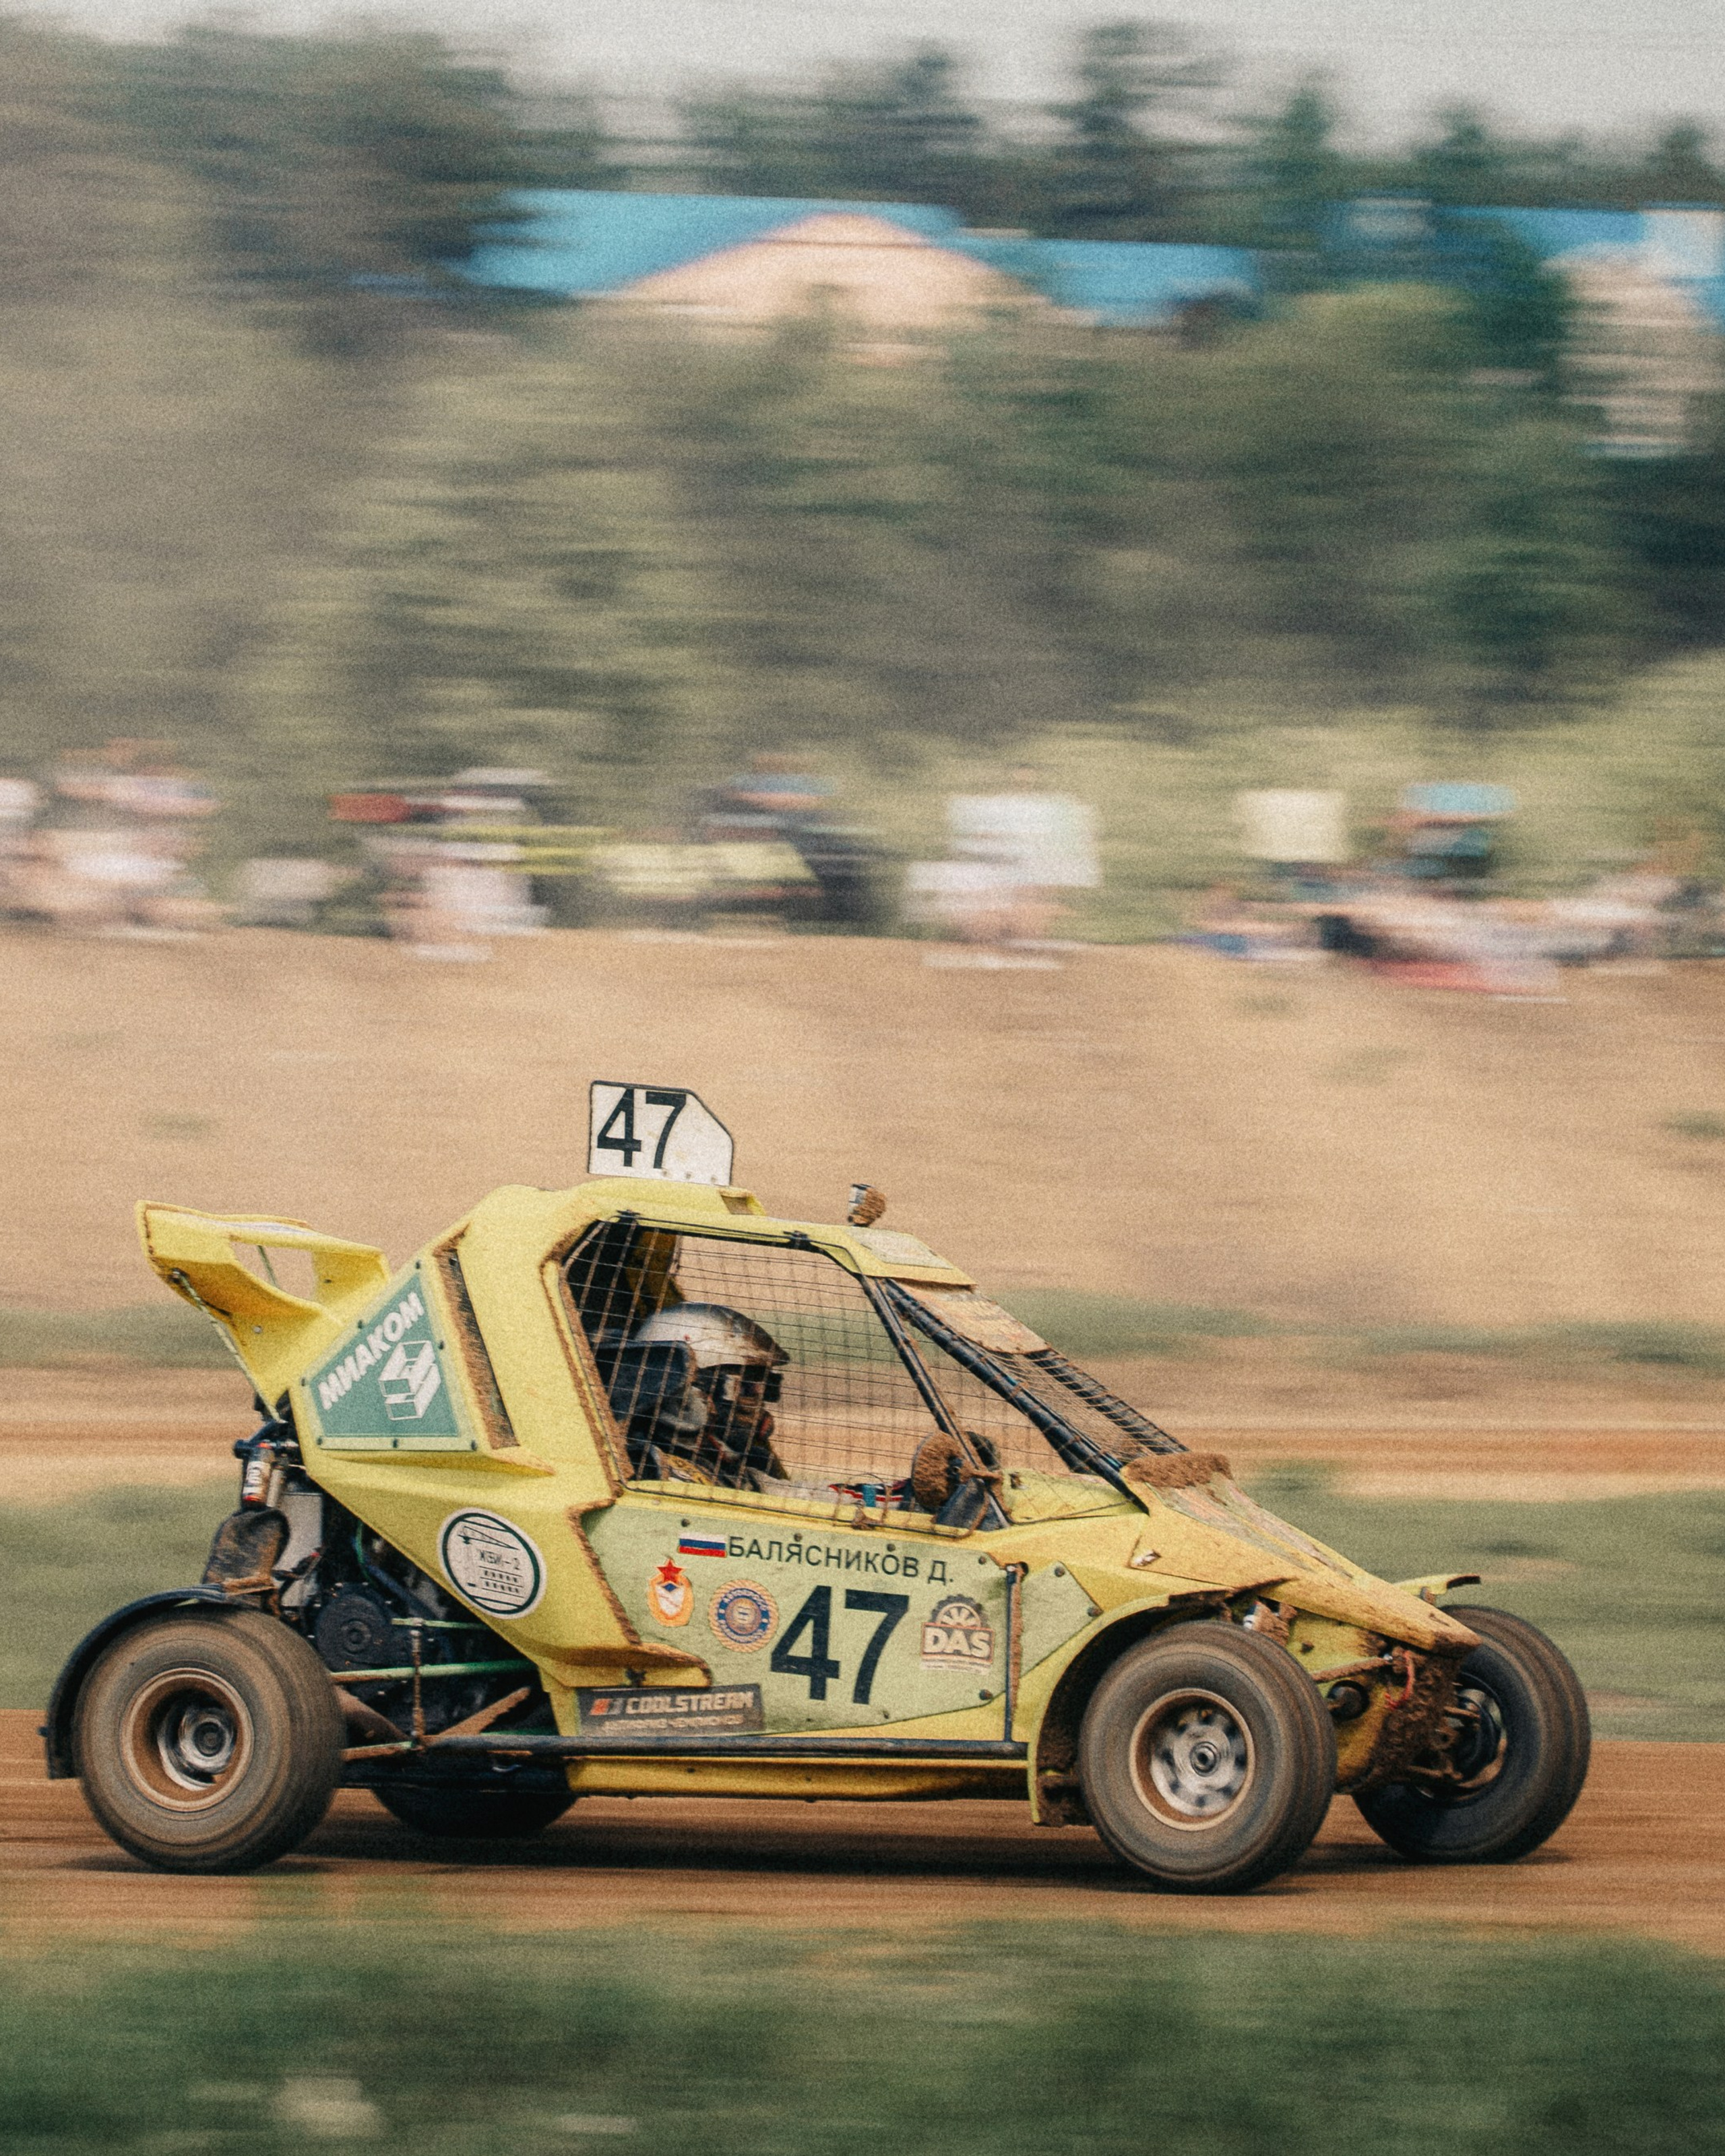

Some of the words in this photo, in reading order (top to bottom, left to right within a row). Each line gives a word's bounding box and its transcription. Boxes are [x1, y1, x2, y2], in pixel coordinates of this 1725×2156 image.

[597, 1088, 687, 1169] 47
[318, 1292, 425, 1410] МИАКОМ
[728, 1535, 919, 1578] БАЛЯСНИКОВ
[927, 1560, 954, 1585] Д.
[770, 1585, 910, 1705] 47
[924, 1626, 992, 1659] DAS
[625, 1691, 755, 1715] COOLSTREAM
